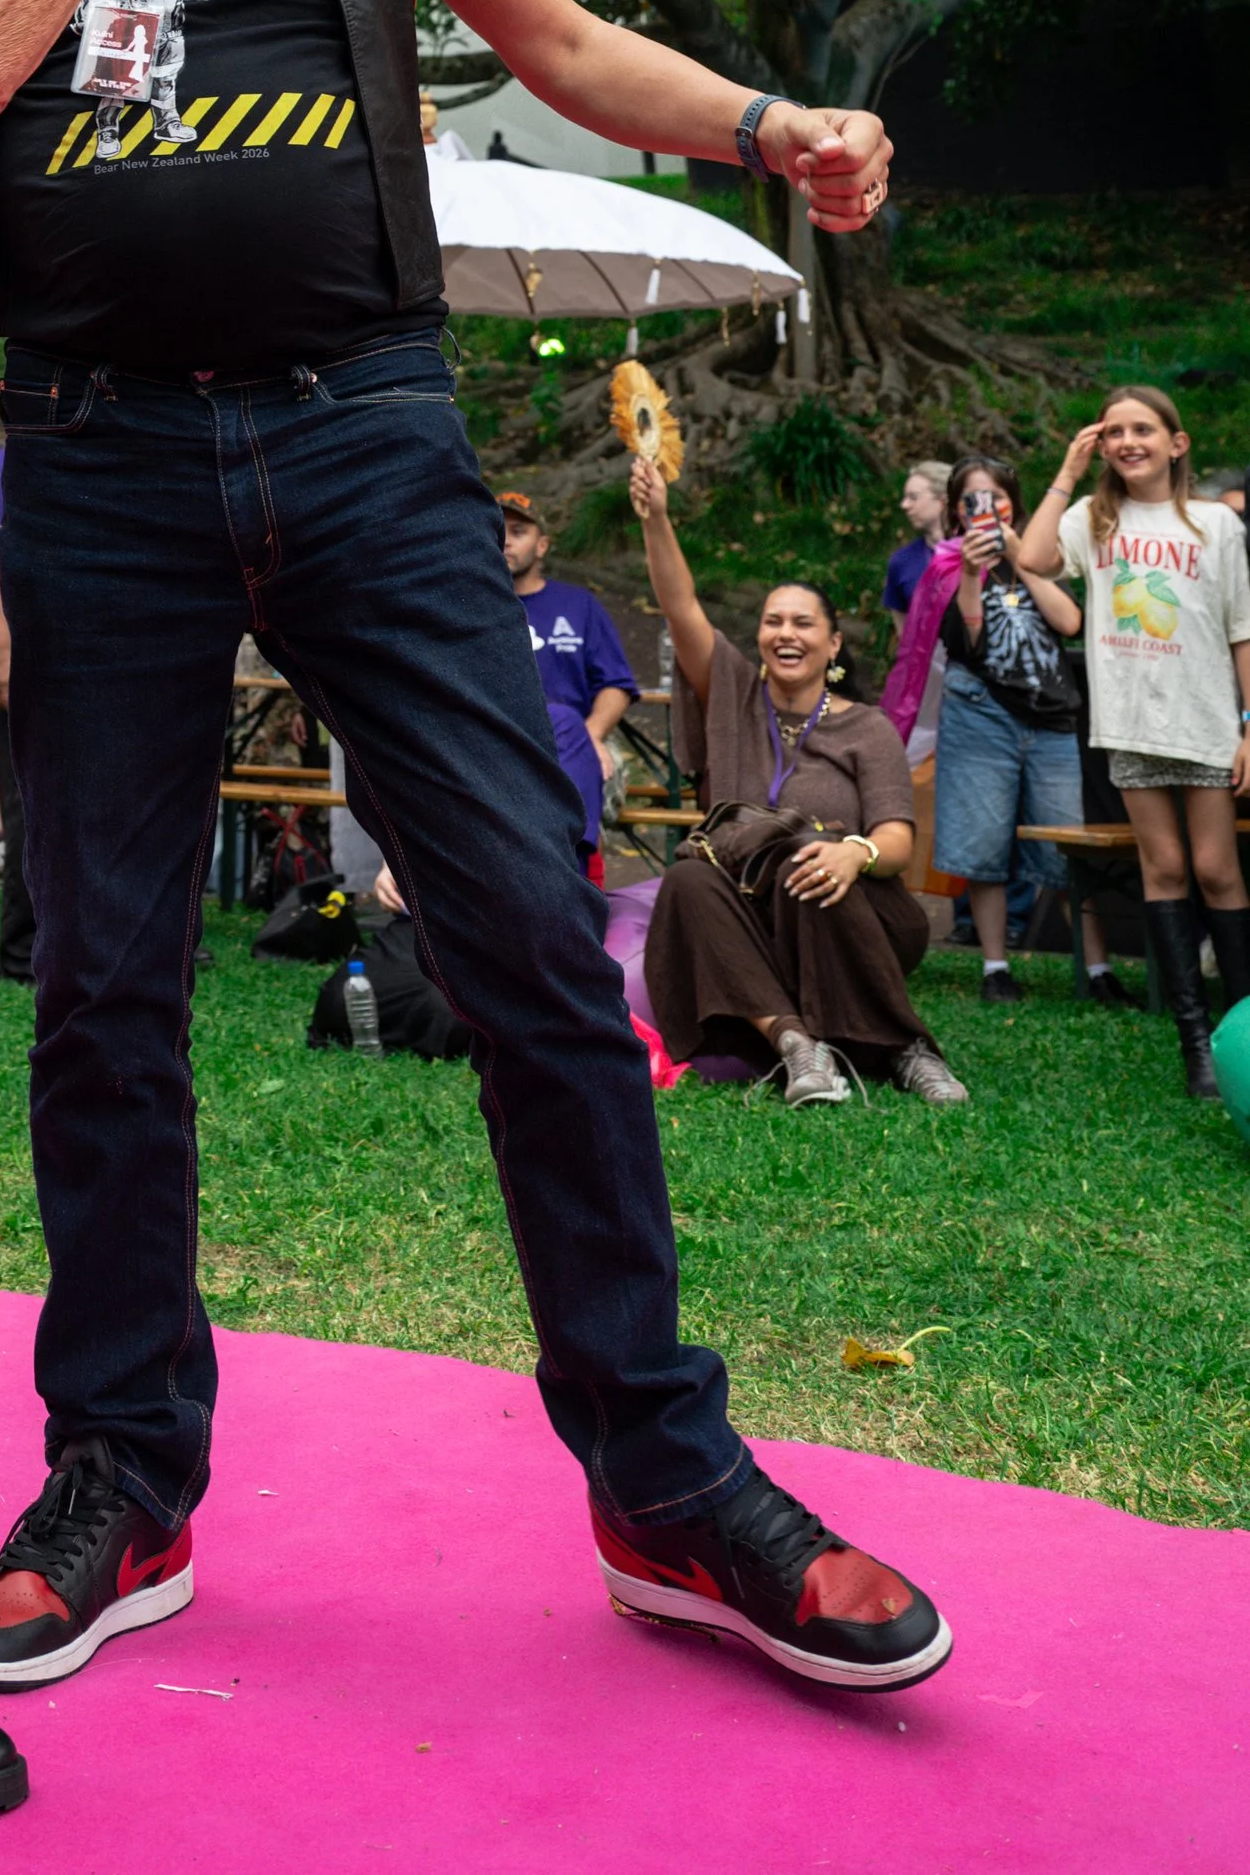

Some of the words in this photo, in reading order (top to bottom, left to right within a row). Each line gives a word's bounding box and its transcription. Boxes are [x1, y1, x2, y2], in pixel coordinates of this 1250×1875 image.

[94, 163, 119, 175] Bear
[121, 159, 149, 170] New
[152, 155, 201, 168] Zealand
[203, 151, 238, 163] Week
[241, 148, 270, 159] 2026
[1096, 534, 1203, 581] LIMONE
